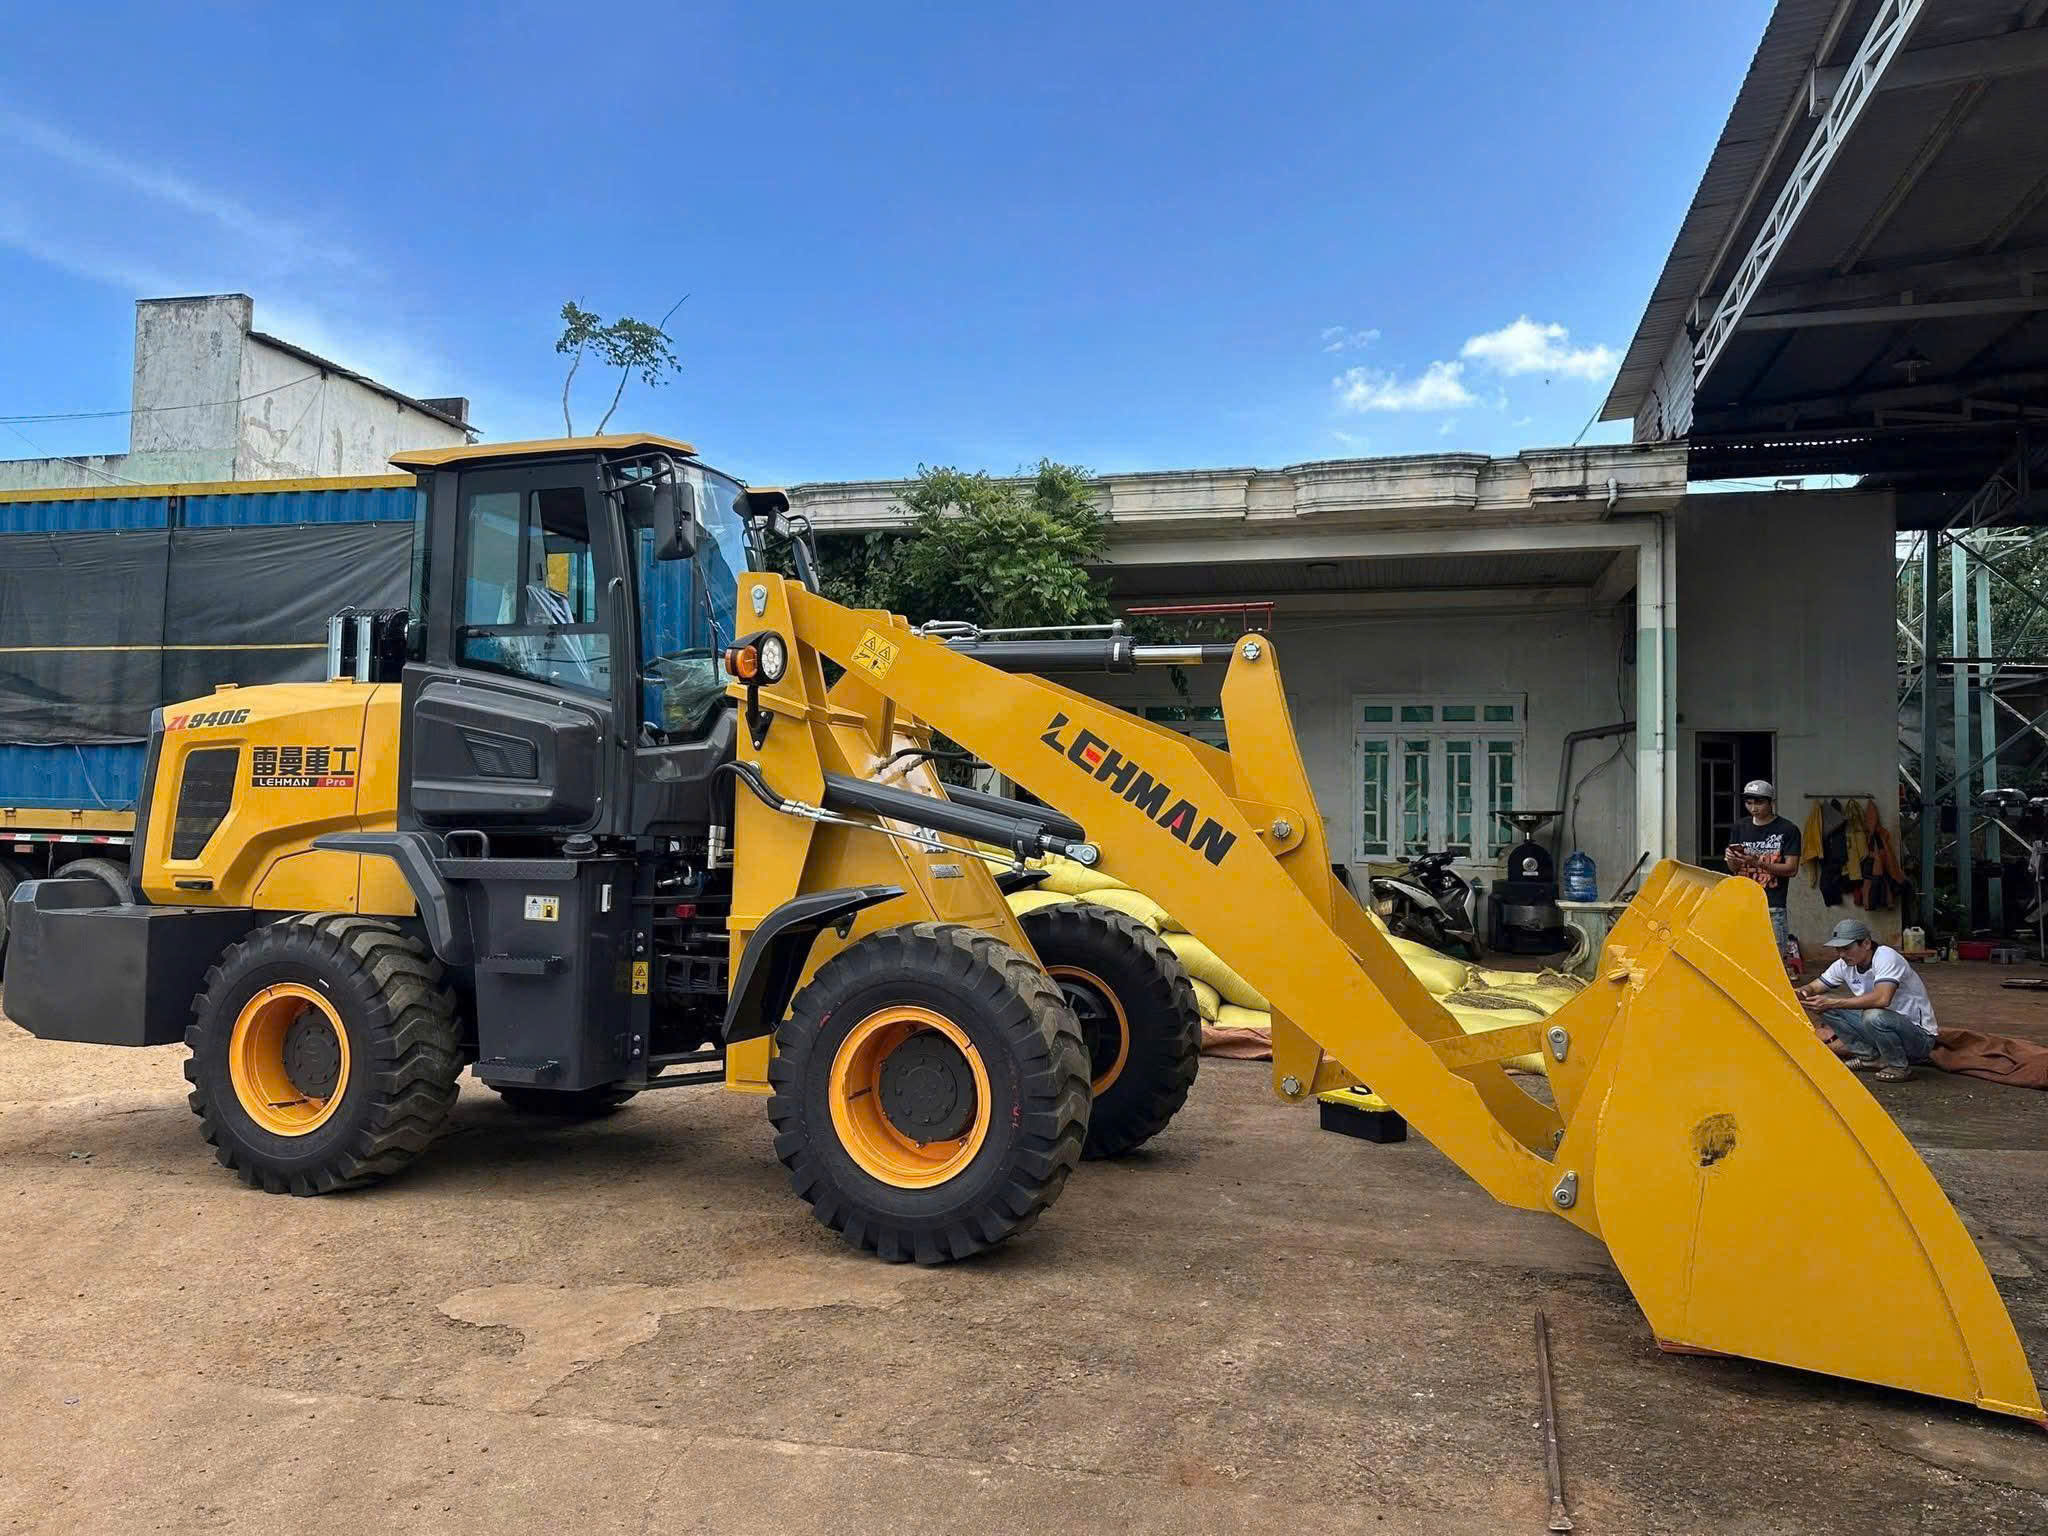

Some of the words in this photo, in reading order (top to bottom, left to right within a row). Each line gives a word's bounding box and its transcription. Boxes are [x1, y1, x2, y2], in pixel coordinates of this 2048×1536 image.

[253, 746, 357, 776] 雷曼重工
[259, 778, 310, 787] LEHMAN
[325, 778, 347, 787] Pro
[1040, 712, 1238, 867] LEHMAN
